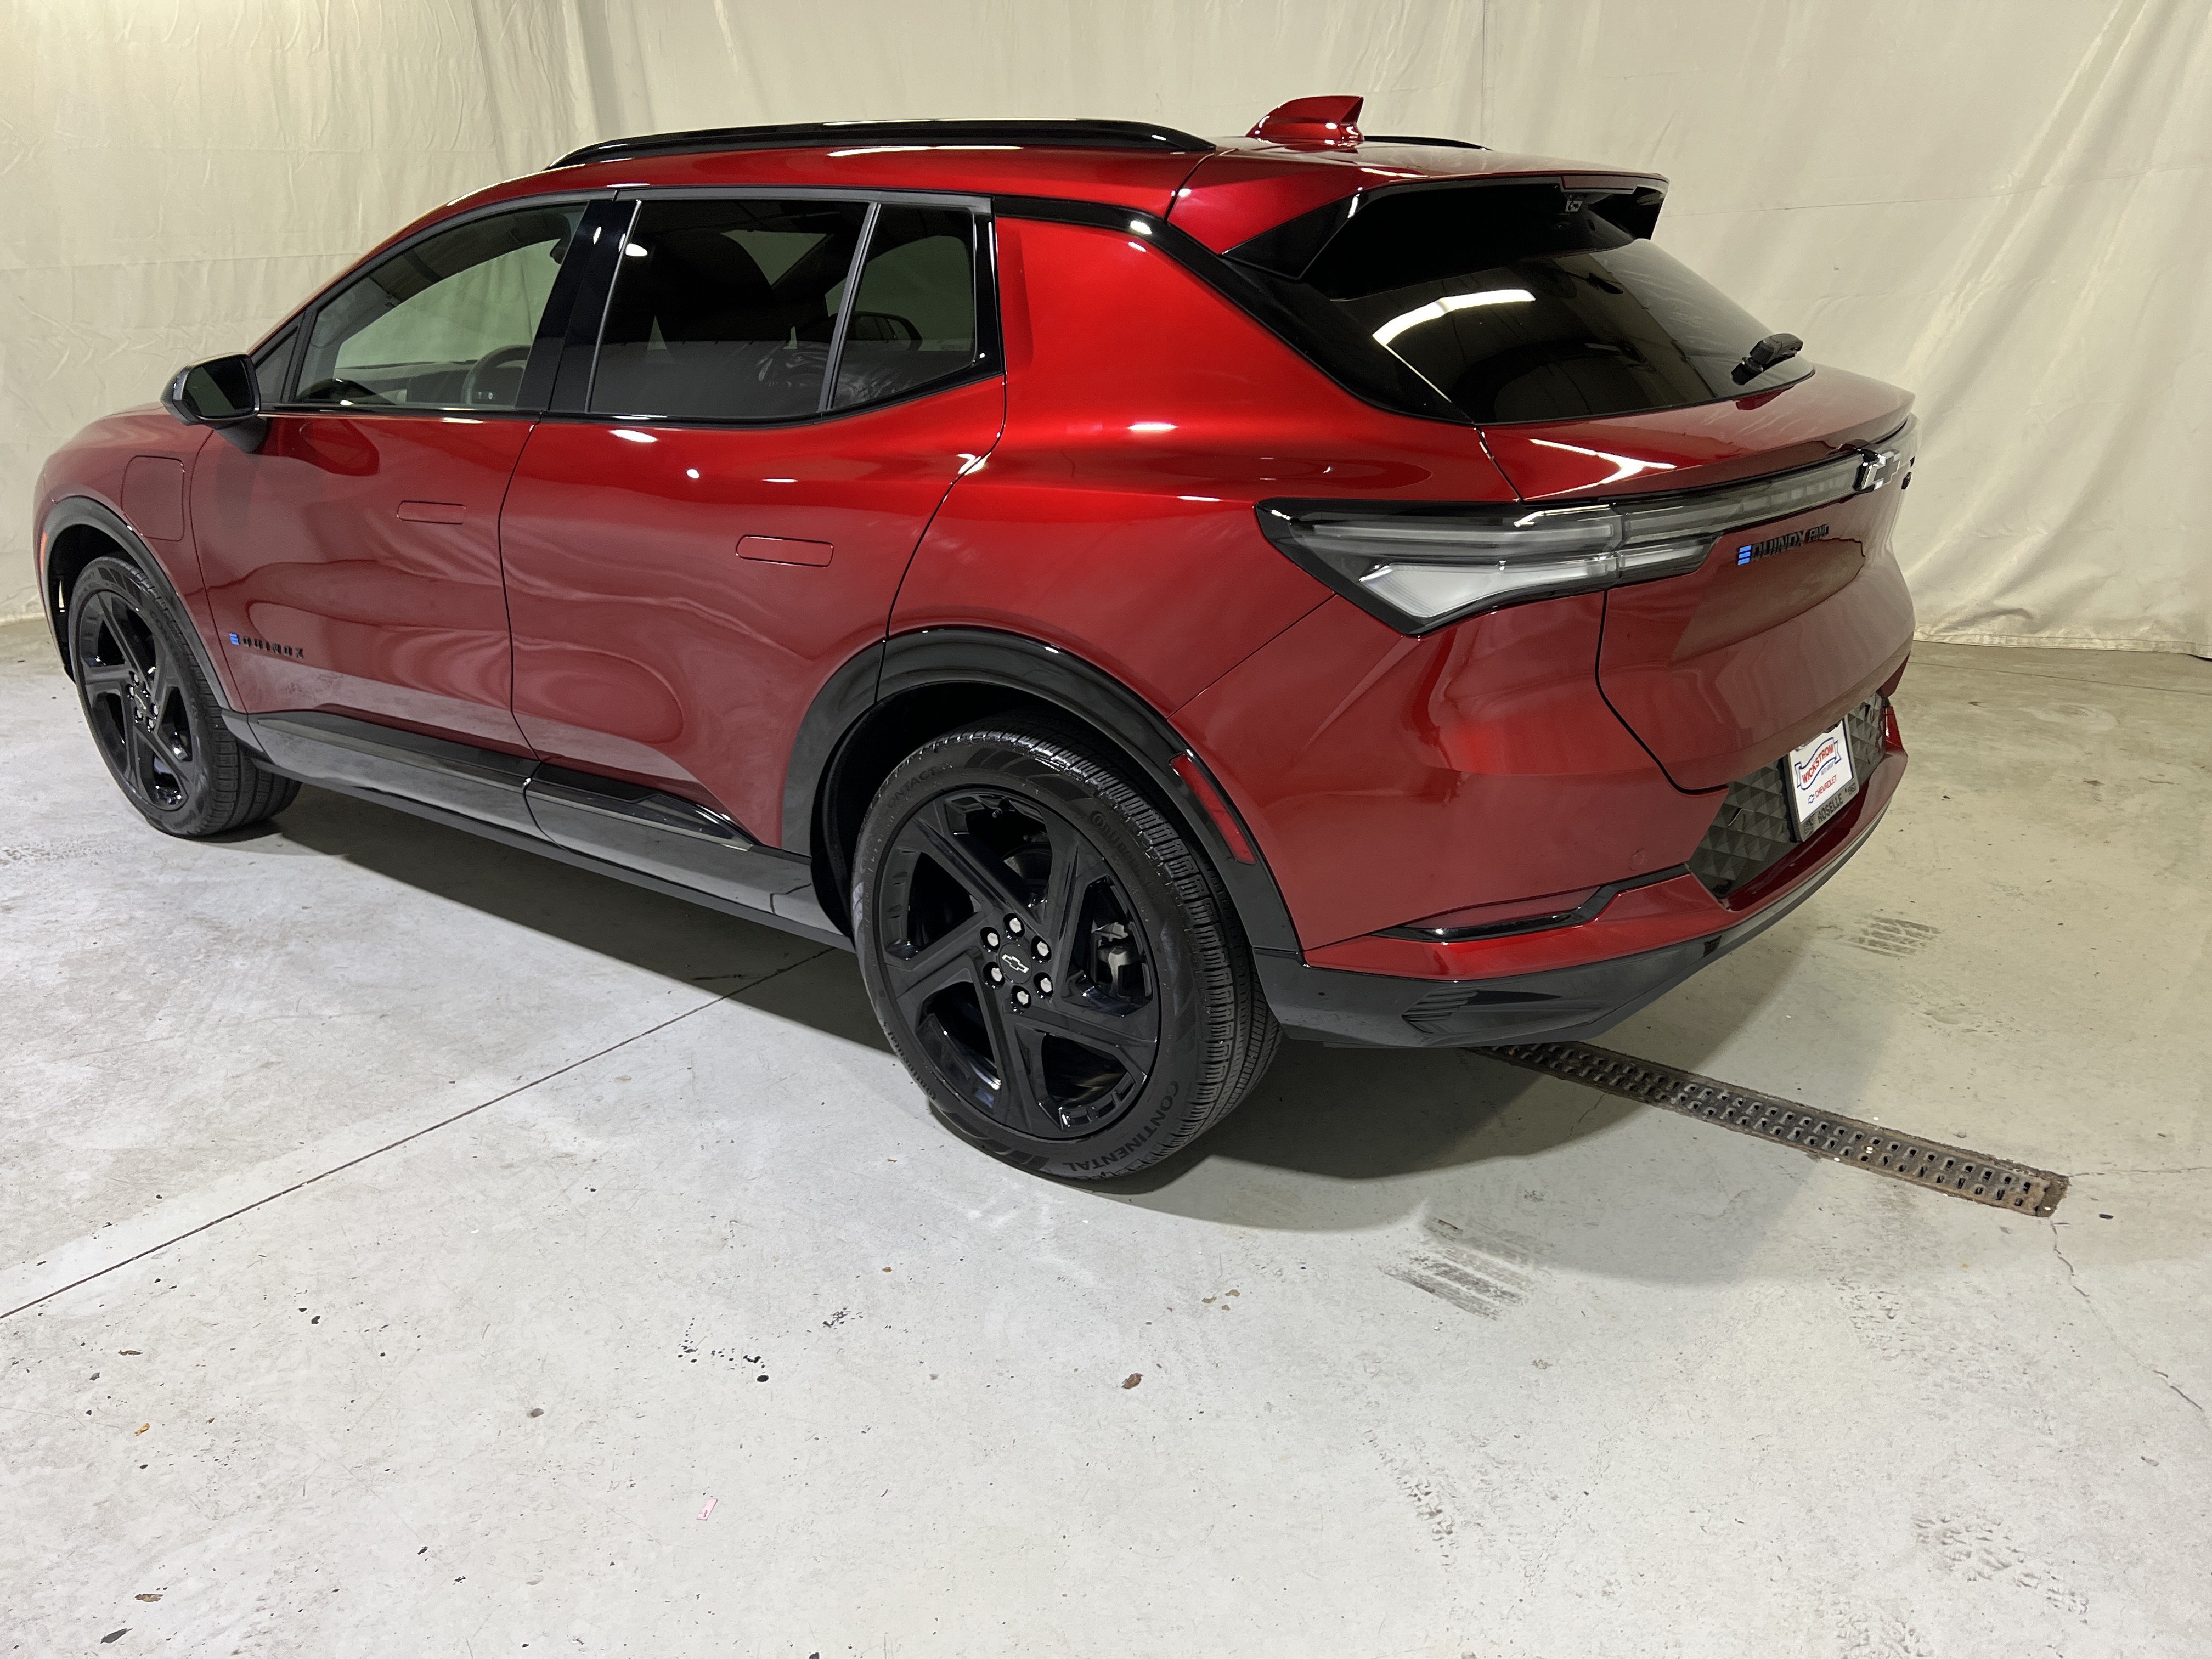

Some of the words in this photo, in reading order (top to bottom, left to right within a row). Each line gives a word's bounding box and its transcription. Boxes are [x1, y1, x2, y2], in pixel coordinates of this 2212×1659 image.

[1802, 743, 1835, 784] WICKSTROM
[1815, 774, 1837, 798] CHEVROLET
[1817, 793, 1843, 824] ROSELLE
[1063, 1081, 1179, 1171] CONTINENTAL
